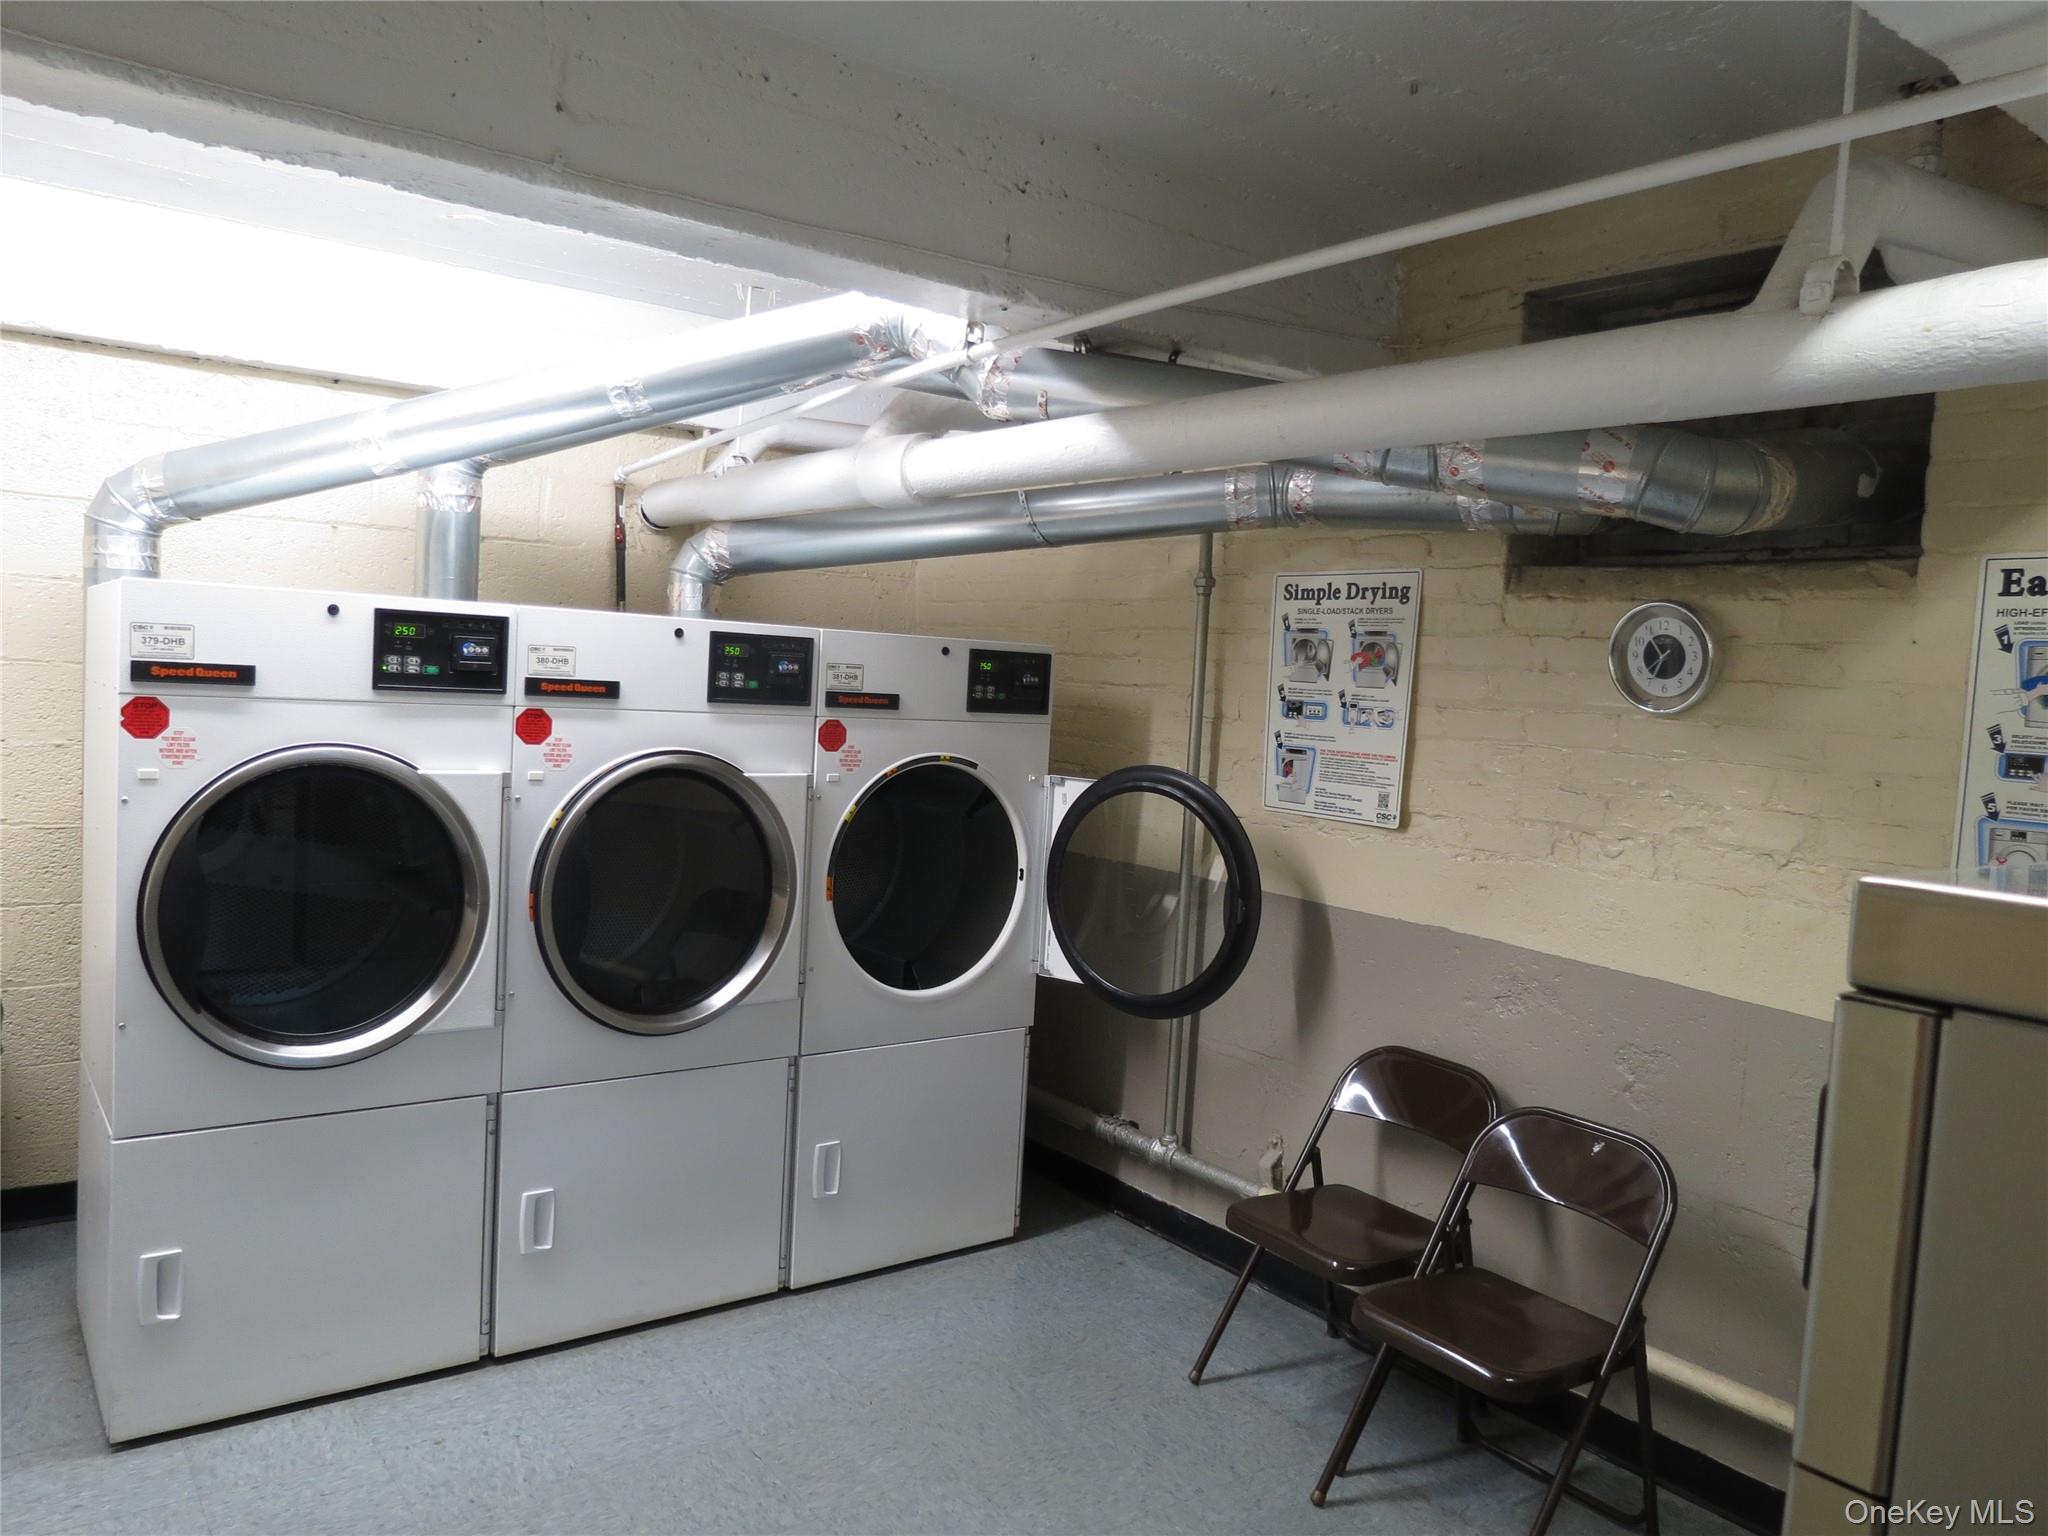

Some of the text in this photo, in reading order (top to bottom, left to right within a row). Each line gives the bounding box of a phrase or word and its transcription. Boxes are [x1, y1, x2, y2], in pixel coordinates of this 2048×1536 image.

[1283, 582, 1411, 605] Simple Drying
[1297, 607, 1393, 615] SINGLE-LOAD/STACK DRYERS
[1659, 620, 1671, 630] 12
[394, 626, 416, 636] 250
[141, 636, 186, 646] 379-DHB
[1635, 636, 1645, 646] 10
[1688, 636, 1696, 647] 2
[2001, 635, 2008, 644] 1
[536, 656, 569, 665] 380-DHB
[1632, 652, 1639, 661] 9
[1691, 651, 1699, 661] 3
[151, 665, 237, 678] Speed Queen
[540, 682, 607, 693] Speed Queen
[1661, 684, 1669, 693] 6
[838, 695, 864, 705] Speed
[1993, 735, 2002, 744] 3
[1987, 803, 1995, 812] 5
[1376, 812, 1392, 821] CSC
